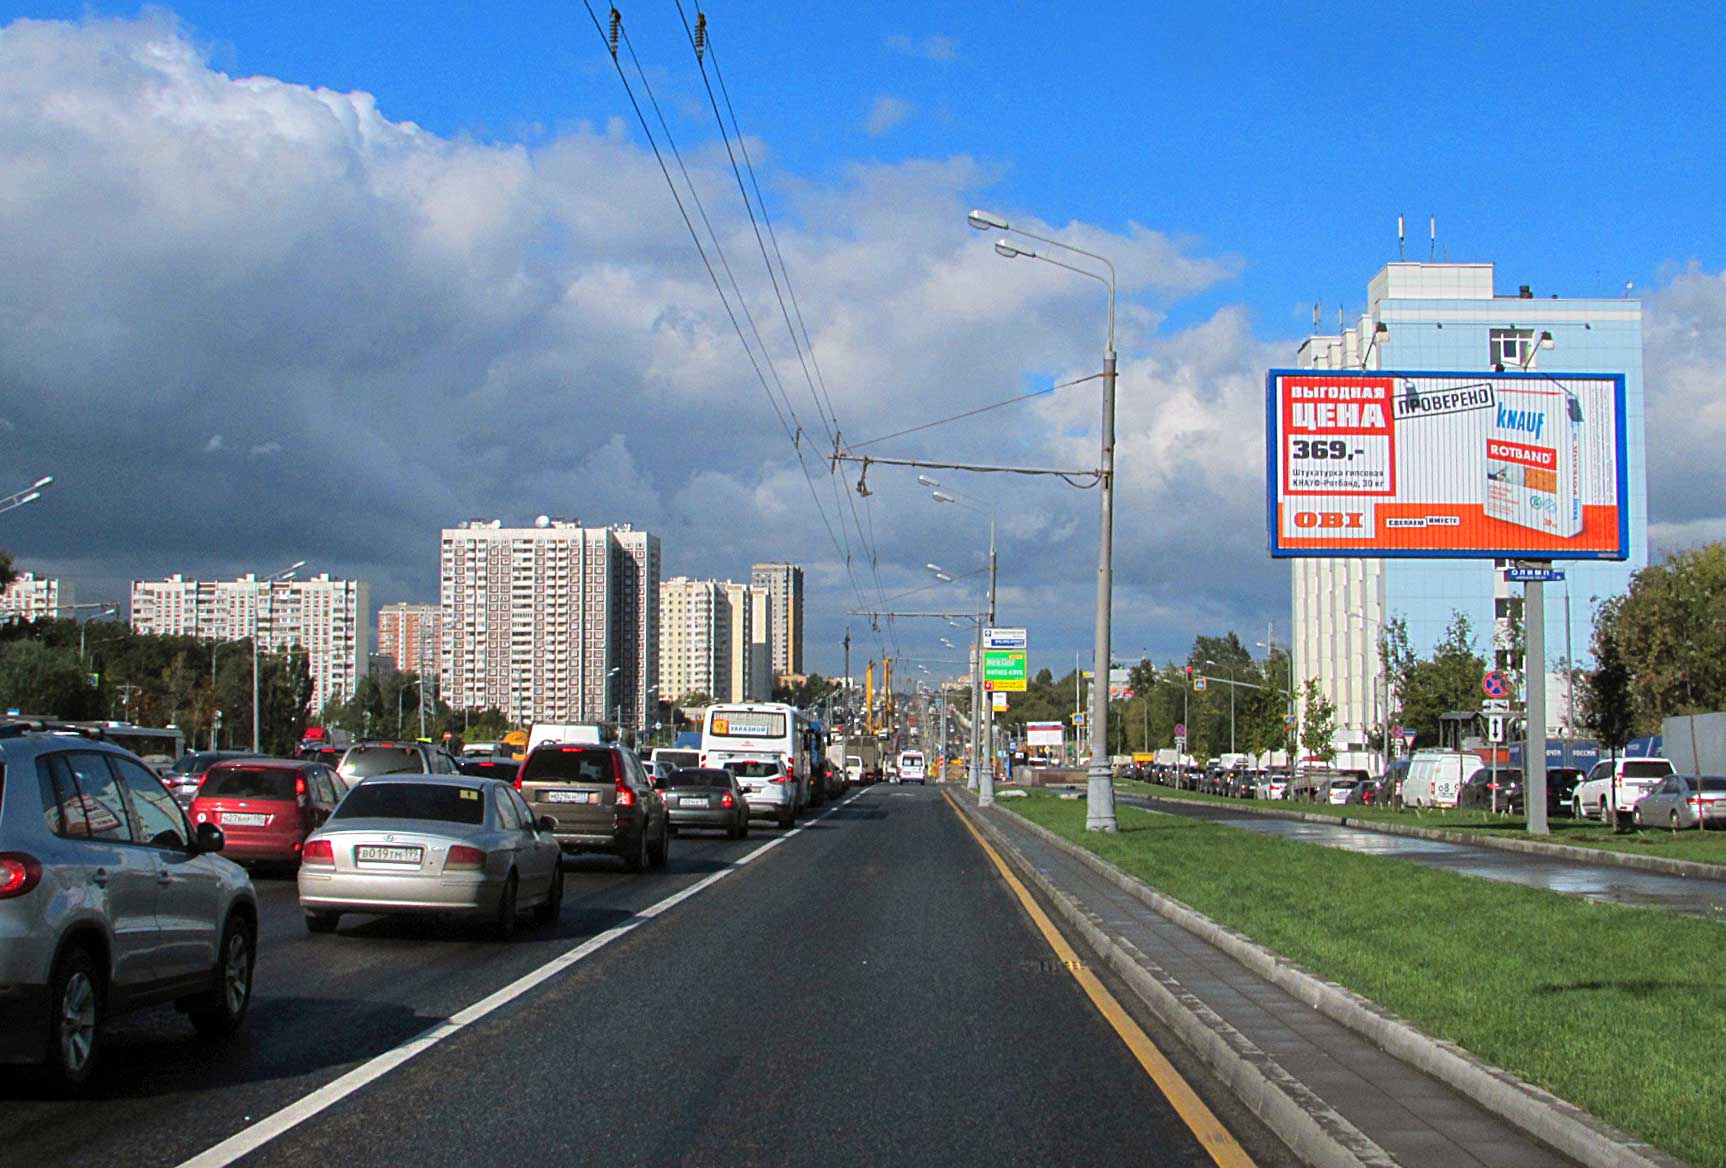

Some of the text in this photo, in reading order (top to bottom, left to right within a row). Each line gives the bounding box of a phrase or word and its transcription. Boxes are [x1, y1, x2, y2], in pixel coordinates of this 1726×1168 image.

[1291, 386, 1385, 400] ВЫГОДНАЯ
[1398, 388, 1489, 415] ПРОВЕРЕНО
[1292, 402, 1386, 431] ЦЕНА
[1496, 402, 1545, 440] KNAUF
[1292, 440, 1364, 461] 369,-
[1490, 444, 1551, 465] ROTBAND
[1292, 468, 1343, 478] Штукатурка
[1362, 480, 1373, 488] 30
[1293, 511, 1364, 529] OBI
